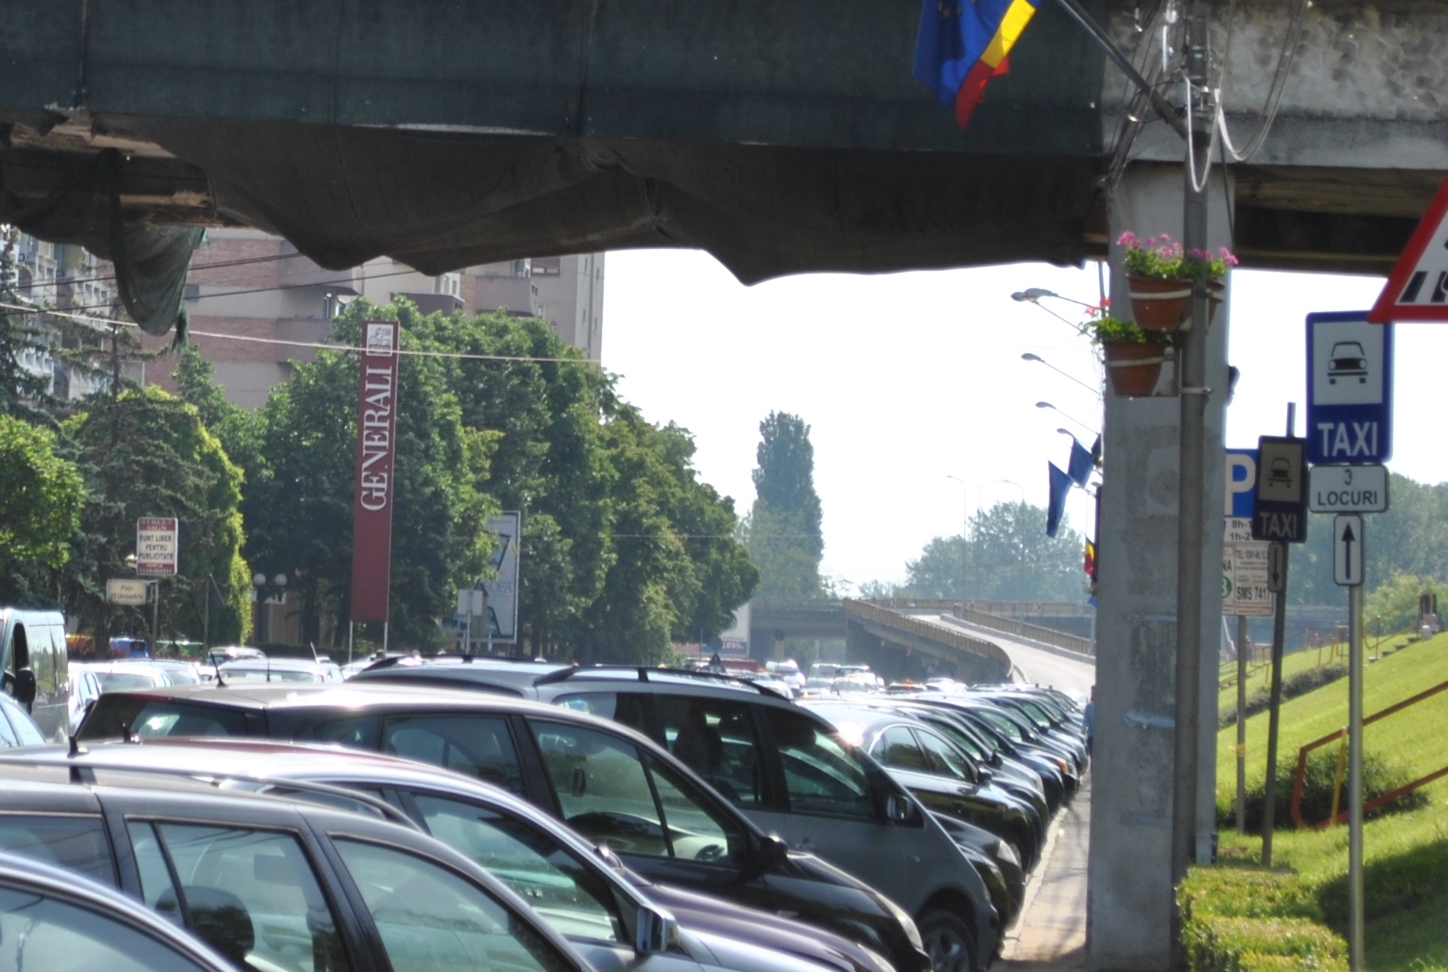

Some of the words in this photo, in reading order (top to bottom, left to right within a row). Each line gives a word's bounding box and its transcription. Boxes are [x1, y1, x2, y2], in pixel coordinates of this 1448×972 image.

[360, 366, 392, 511] GENERALI
[1317, 422, 1378, 457] TAXI
[1344, 469, 1352, 485] 3
[1317, 491, 1378, 506] LOCURI
[1259, 513, 1297, 538] TAXI
